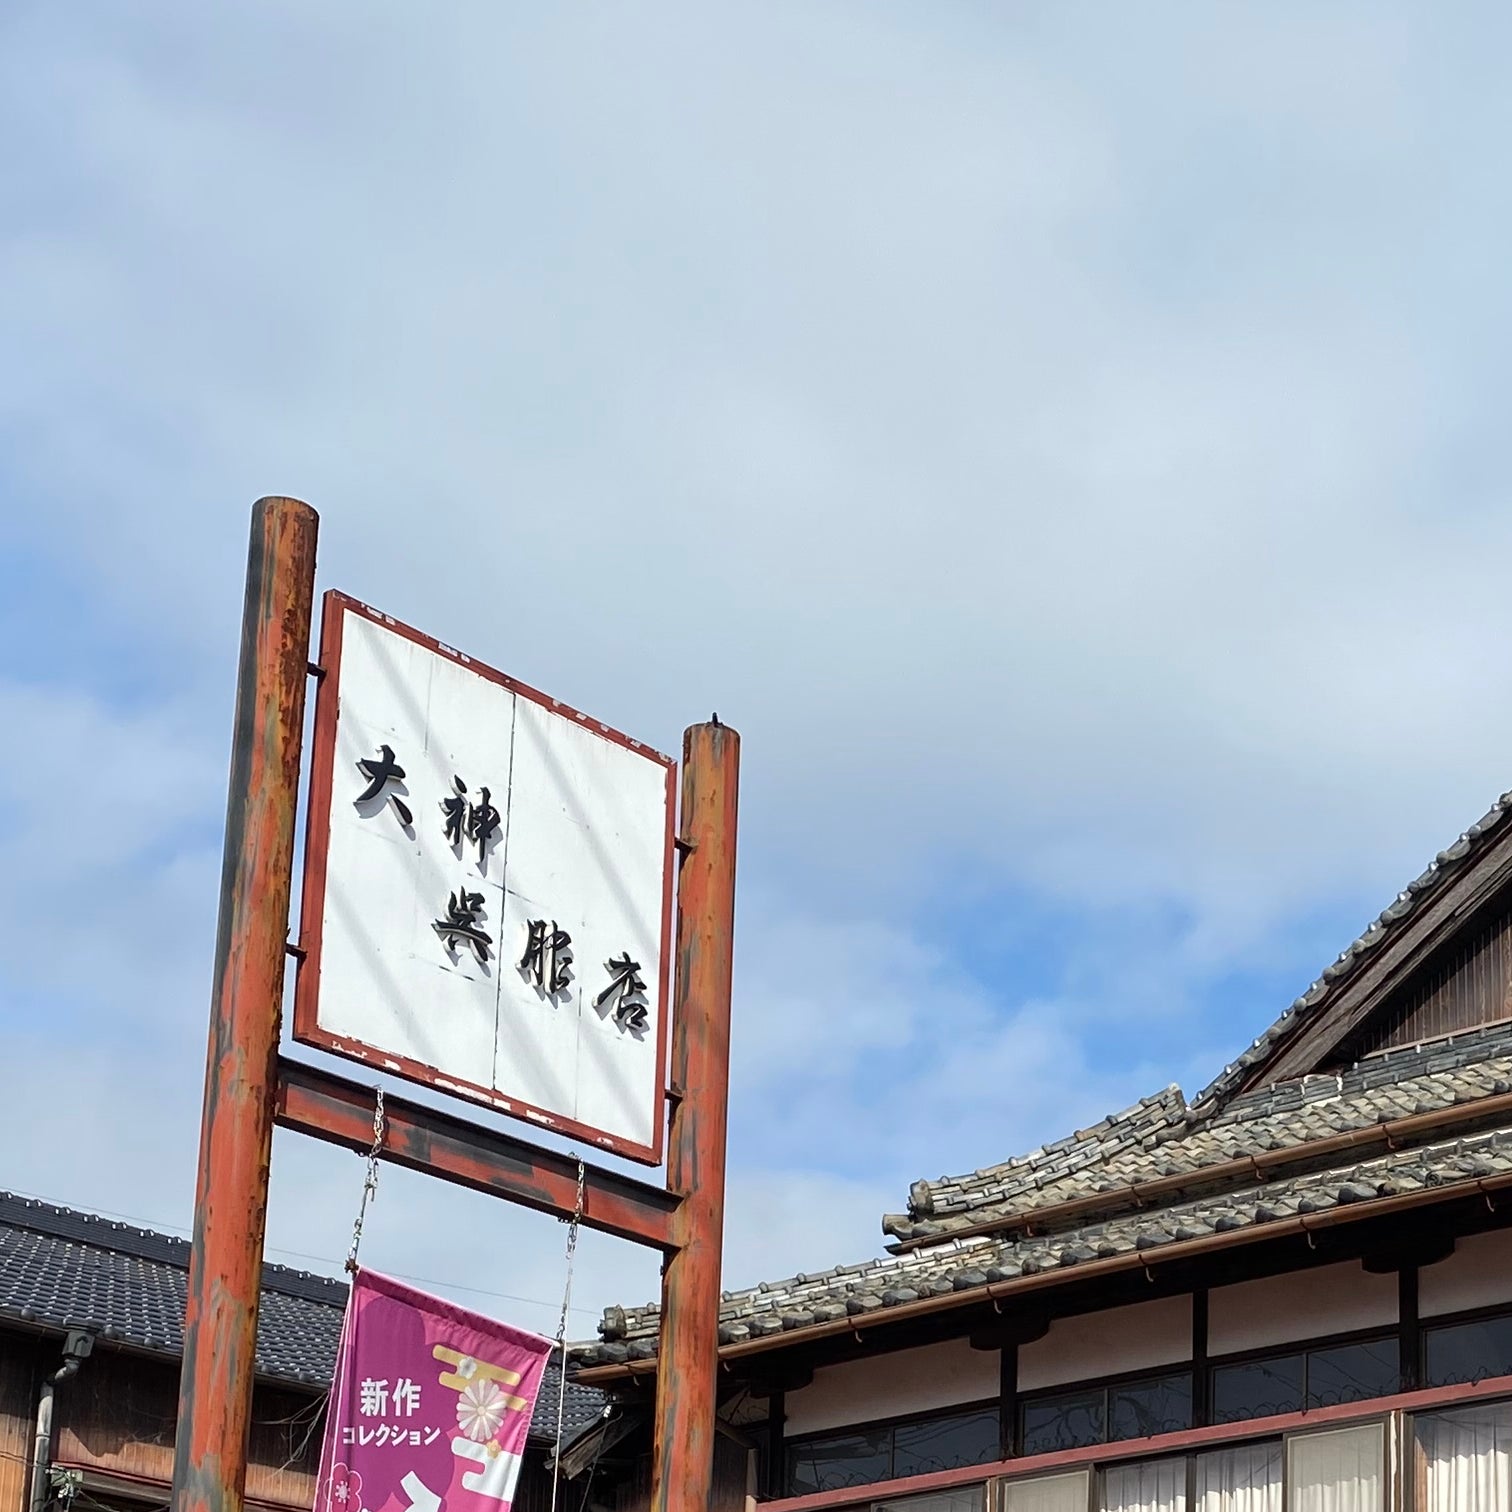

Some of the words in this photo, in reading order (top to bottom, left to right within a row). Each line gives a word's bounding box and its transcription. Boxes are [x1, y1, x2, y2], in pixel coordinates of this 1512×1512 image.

[354, 744, 501, 863] 大神
[432, 886, 649, 1030] 呉服店
[342, 1425, 441, 1447] コレクション
[360, 1377, 422, 1417] 新作
